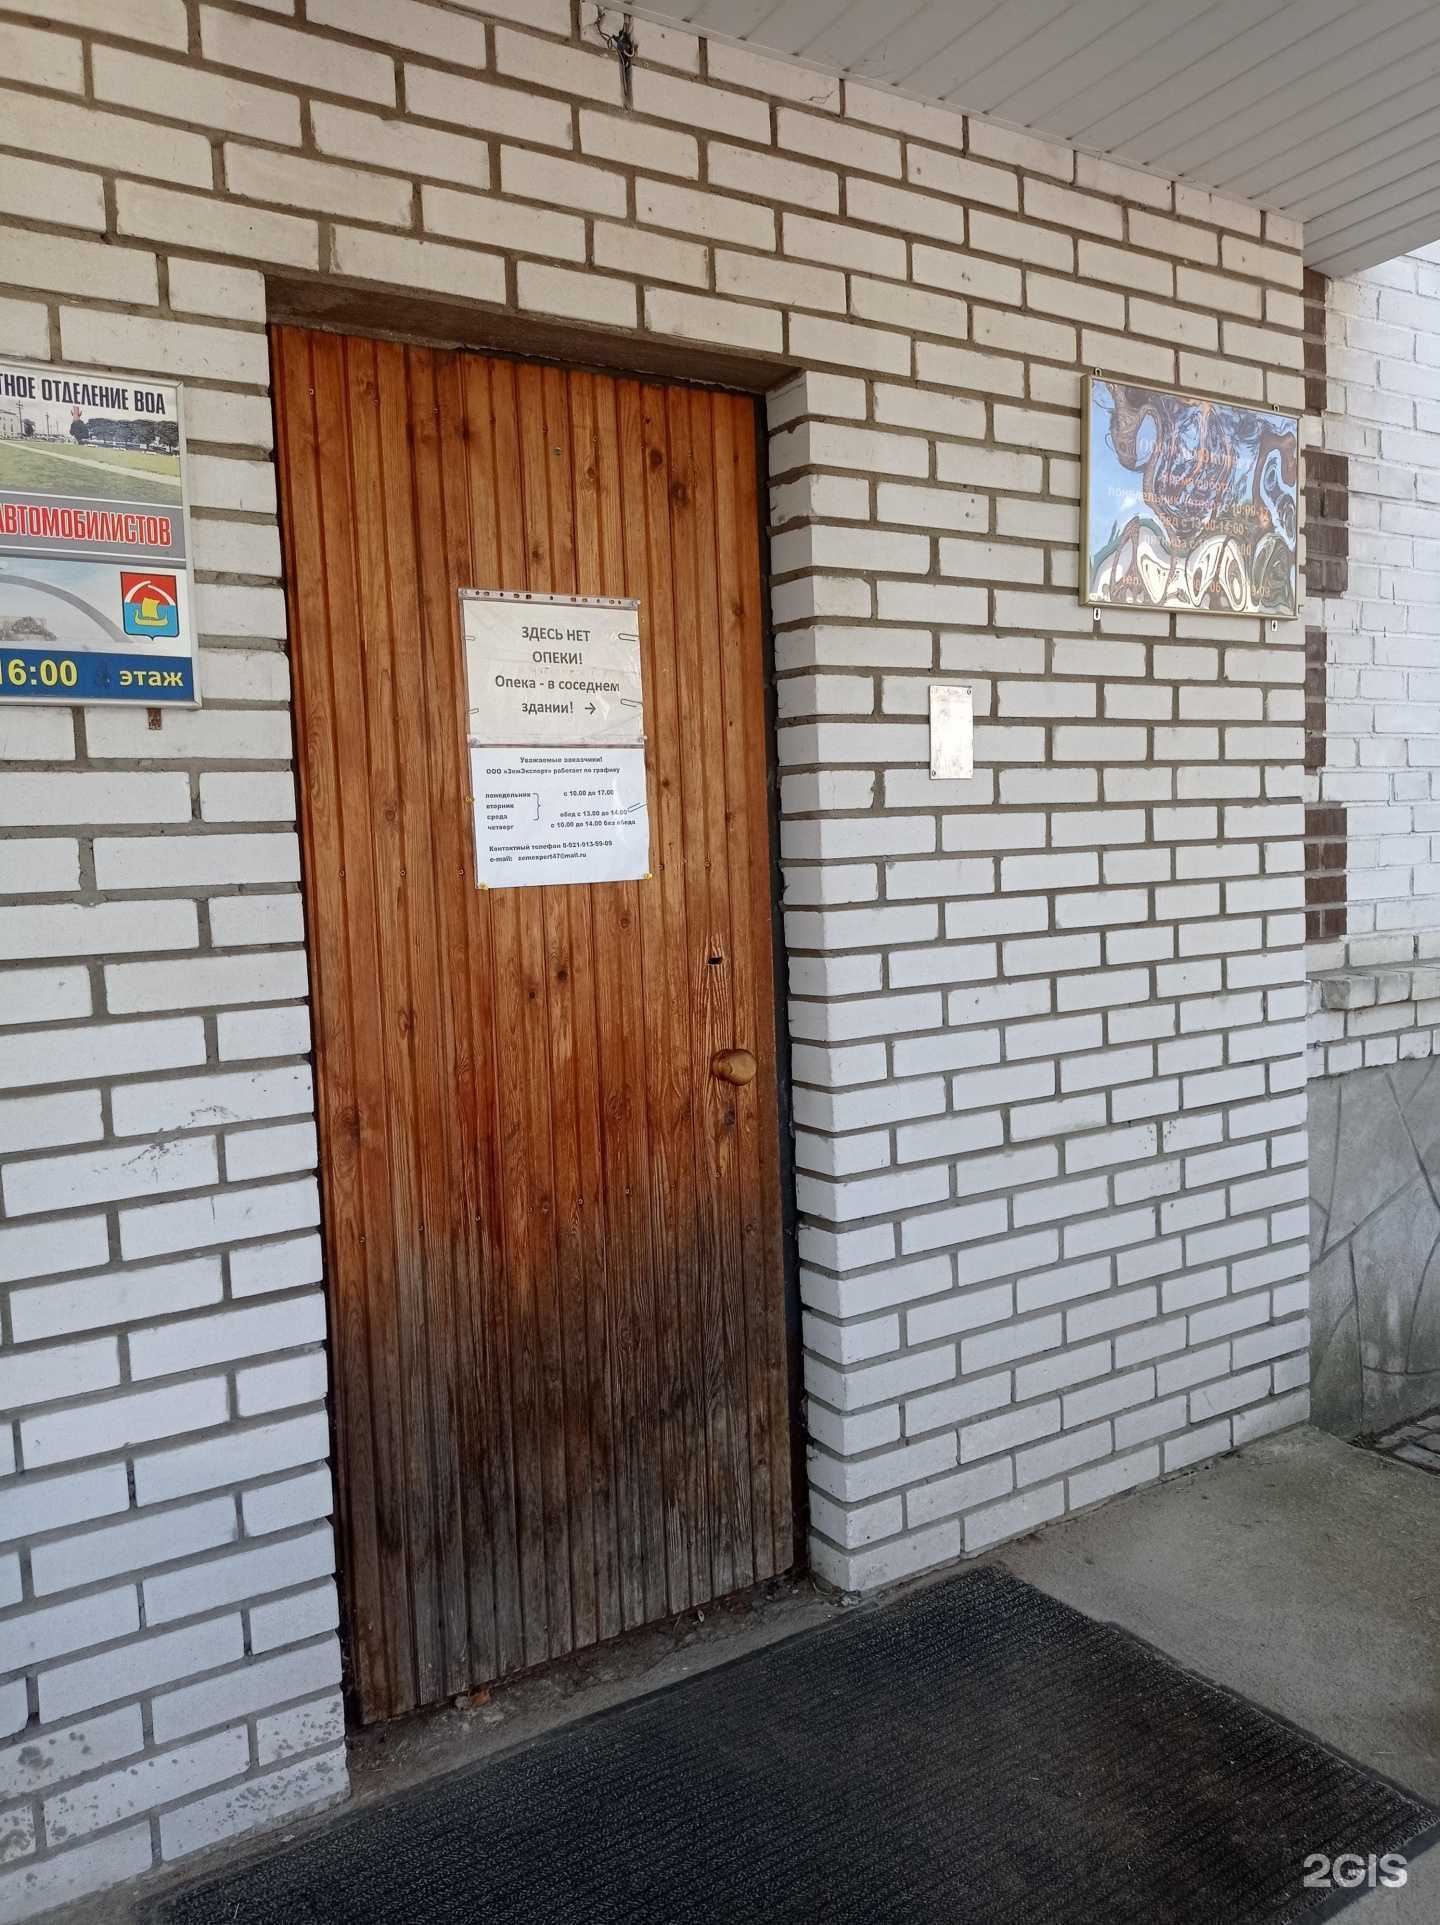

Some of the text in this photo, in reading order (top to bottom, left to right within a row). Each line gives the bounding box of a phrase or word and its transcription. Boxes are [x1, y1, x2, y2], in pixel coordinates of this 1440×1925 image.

[42, 379, 129, 411] ОТДЕЛЕНИЕ
[134, 389, 166, 415] ВОА
[522, 626, 590, 643] ЗДЕСЬ НЕТ
[532, 651, 583, 665] ОПЕКИ!
[119, 669, 184, 688] этаж
[495, 675, 536, 689] Опека
[548, 681, 555, 690] в
[558, 680, 620, 694] соседнем
[522, 701, 574, 715] здании!
[592, 767, 620, 775] графику
[489, 844, 530, 852] Контактный
[489, 855, 513, 863] e-mail:
